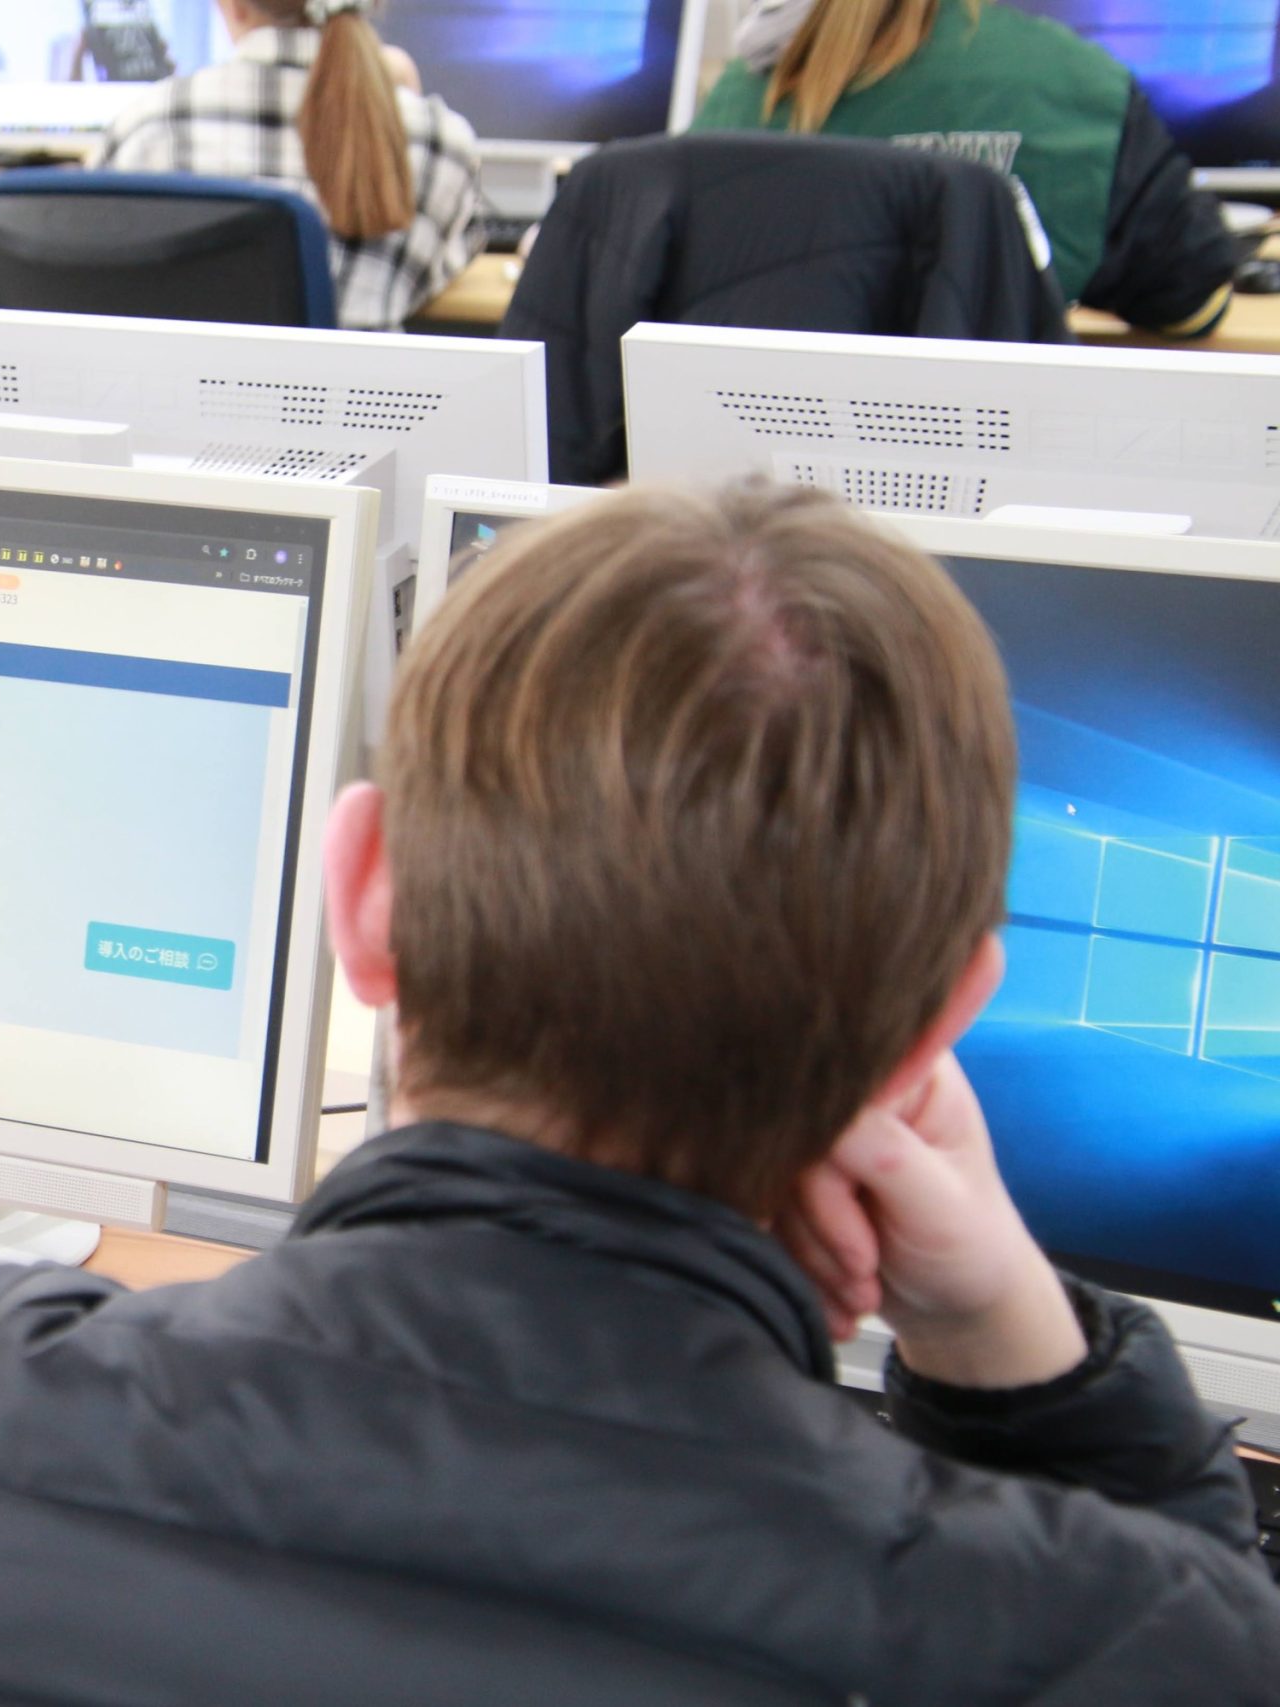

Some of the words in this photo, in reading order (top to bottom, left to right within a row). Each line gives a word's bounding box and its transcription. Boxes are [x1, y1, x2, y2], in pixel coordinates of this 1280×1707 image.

[96, 938, 190, 970] 導入のご相談
